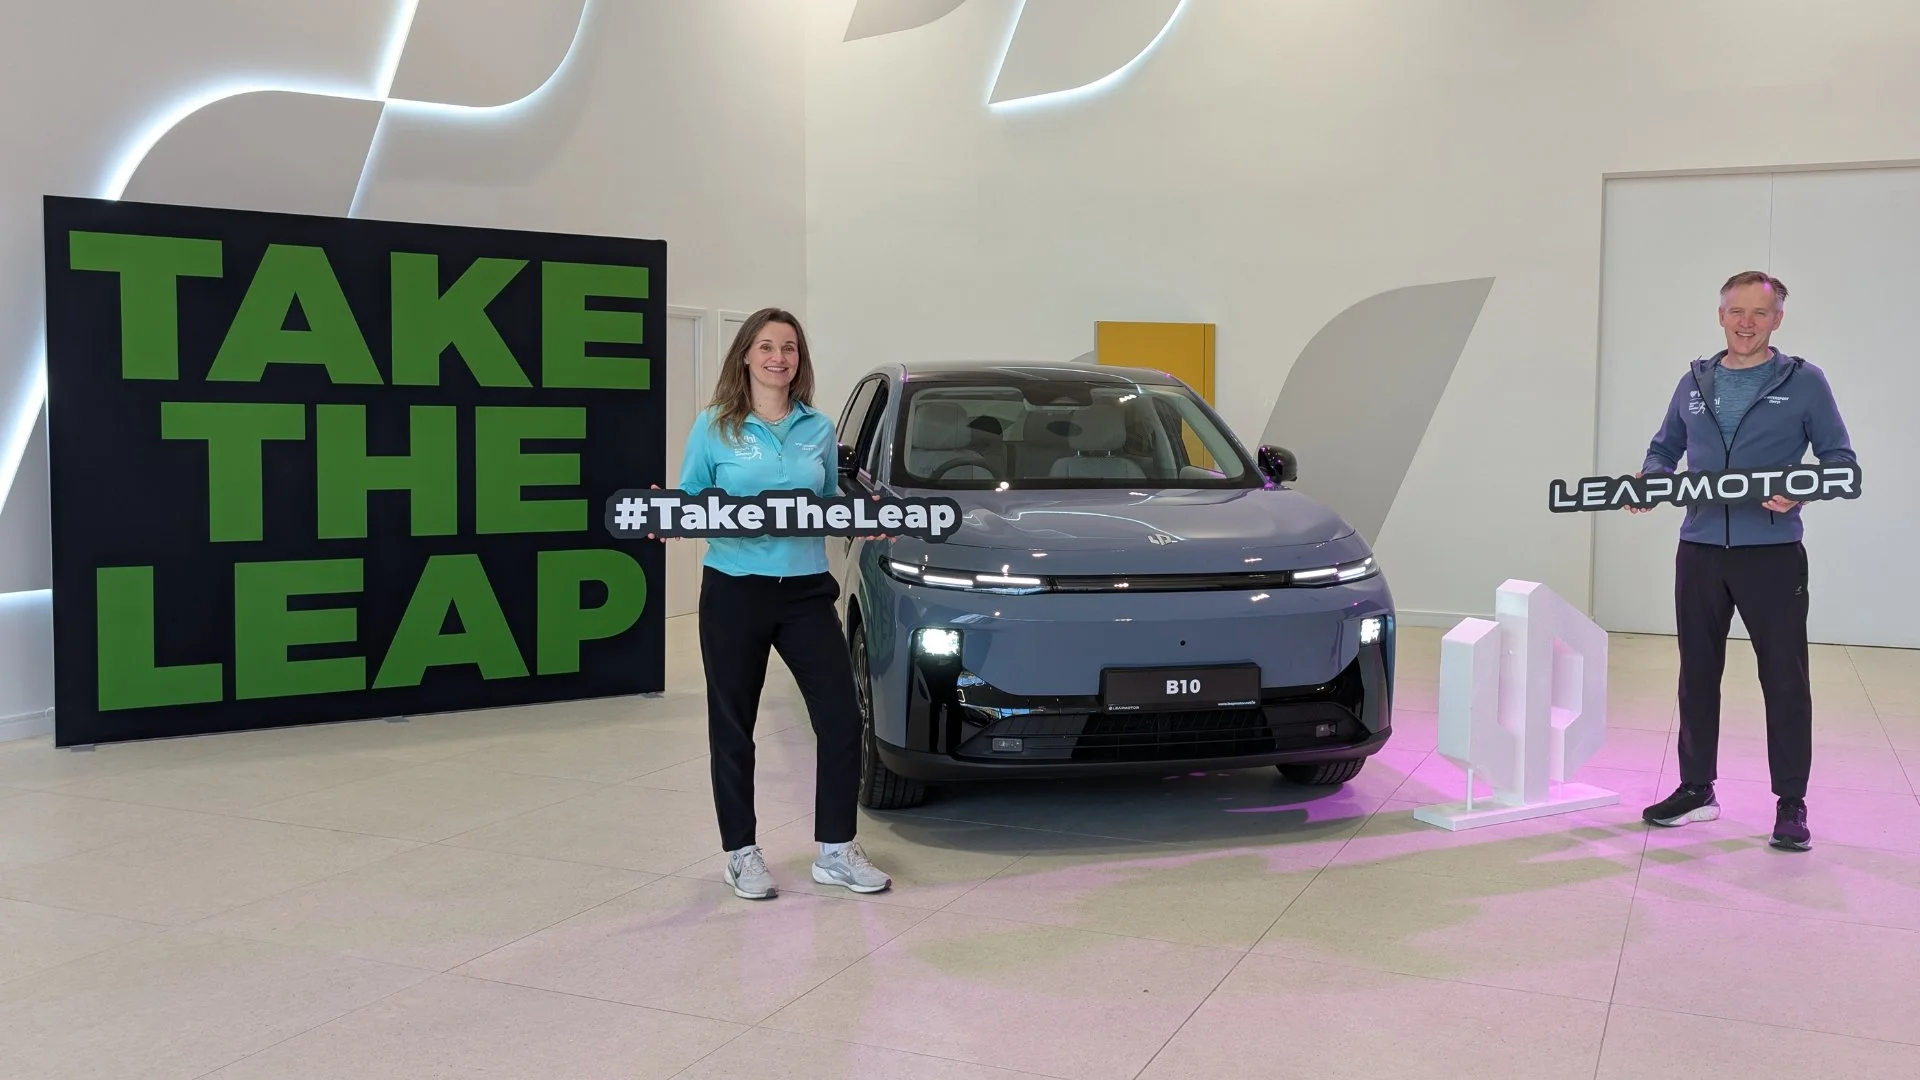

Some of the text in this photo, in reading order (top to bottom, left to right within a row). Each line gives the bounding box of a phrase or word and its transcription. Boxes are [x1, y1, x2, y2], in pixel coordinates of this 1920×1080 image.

[69, 230, 650, 389] TAKE
[161, 402, 588, 542] THE
[614, 496, 956, 536] #TakeTheLeap
[1554, 467, 1854, 507] LEAPMOTOR
[97, 549, 646, 711] LEAP
[1166, 679, 1201, 695] B10
